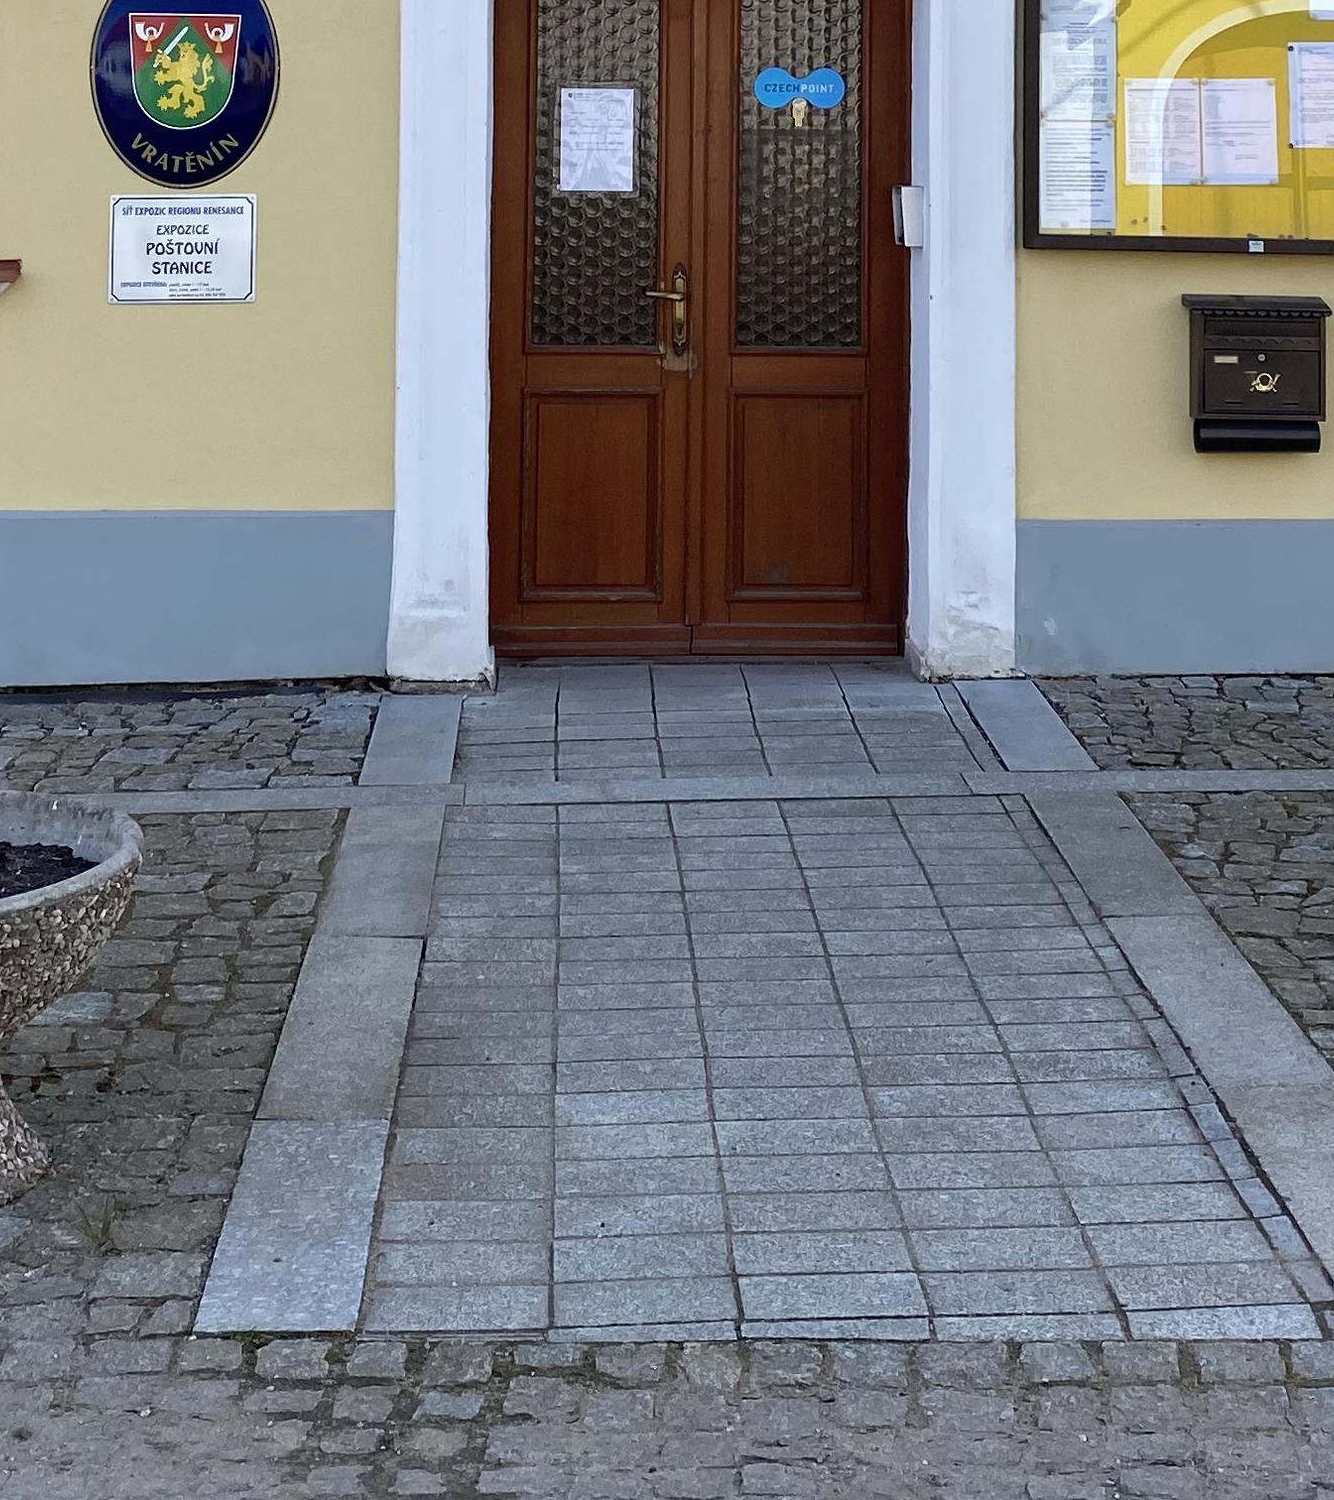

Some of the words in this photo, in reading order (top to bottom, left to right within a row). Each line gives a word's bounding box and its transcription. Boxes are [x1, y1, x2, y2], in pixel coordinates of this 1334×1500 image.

[131, 132, 240, 173] VRATĚNÍN
[135, 207, 166, 216] EXPOZIC
[168, 206, 201, 215] REGIONU
[203, 206, 244, 215] RENESANCE
[156, 224, 209, 236] EXPOZICE
[146, 238, 220, 256] POŠTOVNÍ
[152, 261, 212, 275] STANICE
